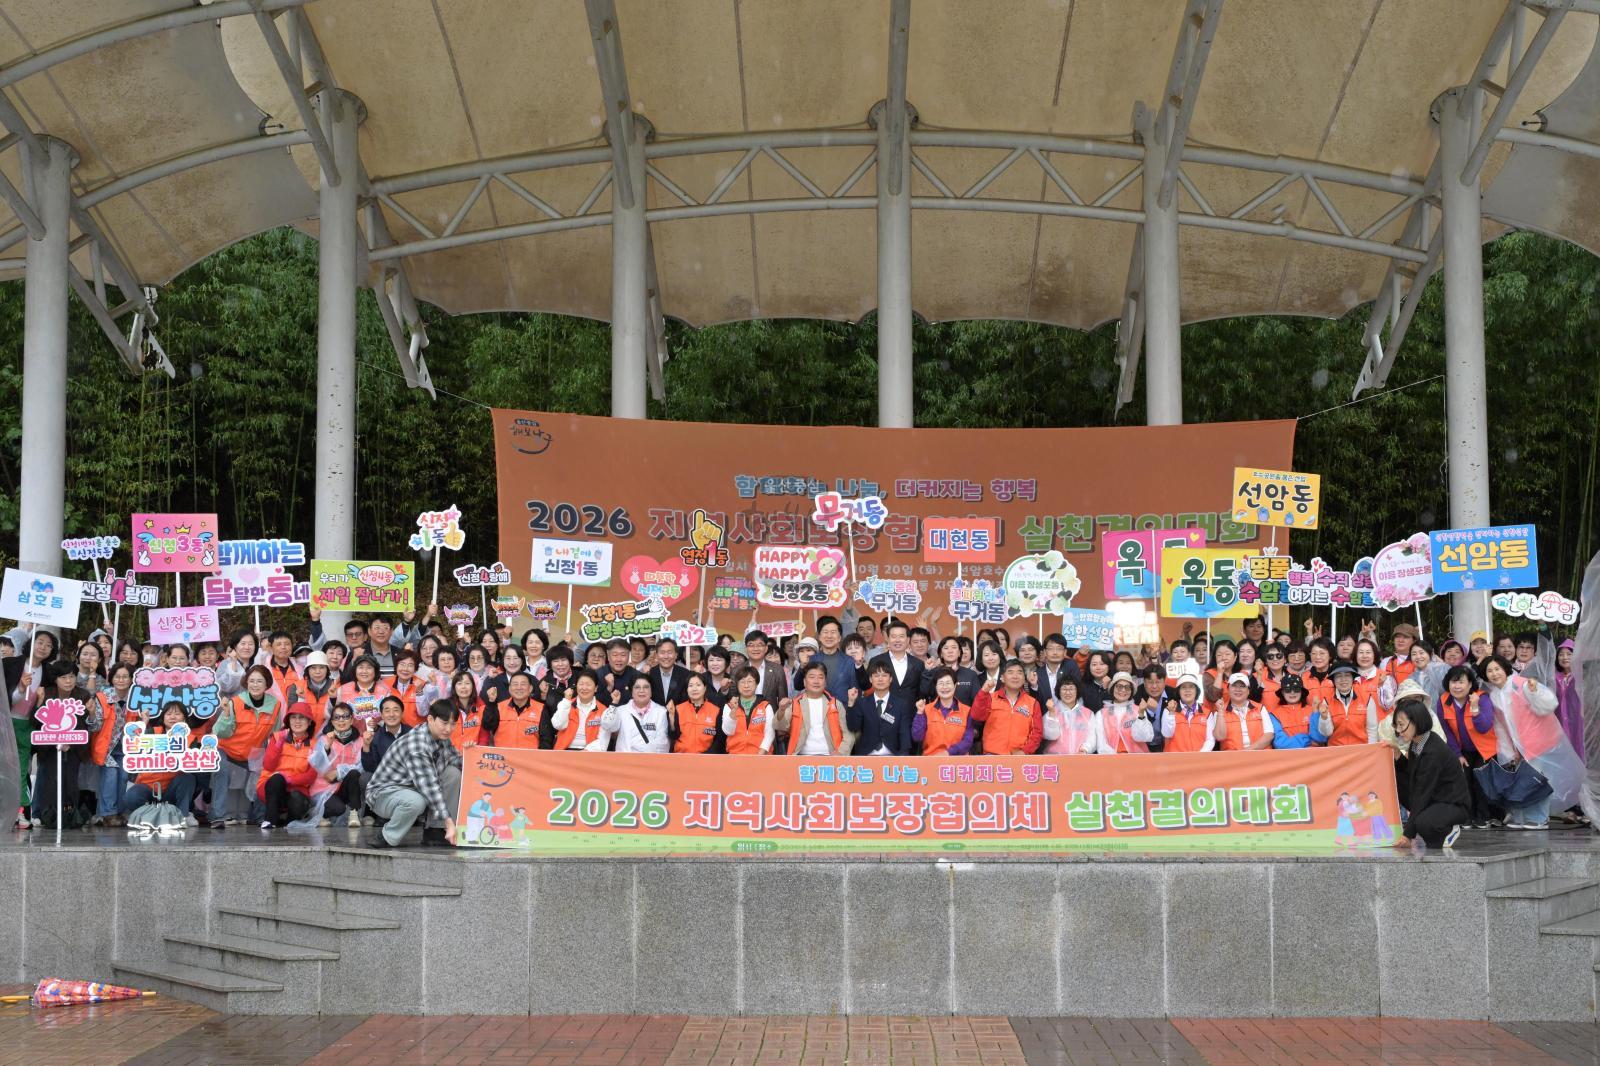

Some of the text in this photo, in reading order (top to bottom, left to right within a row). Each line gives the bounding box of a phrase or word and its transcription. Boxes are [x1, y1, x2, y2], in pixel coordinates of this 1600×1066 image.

[895, 479, 982, 502] 더커지는
[990, 478, 1036, 502] 행복
[1239, 481, 1315, 514] 선암동
[420, 511, 449, 529] 신정
[526, 500, 633, 537] 2026
[815, 494, 885, 531] 무거동
[148, 536, 205, 554] 신정3동
[929, 529, 989, 550] 대현동
[78, 546, 112, 558] 신정5동
[218, 540, 303, 566] 함께하는
[681, 541, 729, 567] 열정1동
[759, 550, 811, 564] HAPPY
[1437, 539, 1530, 573] 선암동
[319, 569, 394, 584] 우리가 신정4동
[544, 558, 598, 577] 신정1동
[758, 566, 810, 580] HAPPY
[884, 564, 914, 577] 20일
[1250, 557, 1290, 580] 명품
[1289, 570, 1315, 586] 행복
[1317, 568, 1350, 588] 수직
[80, 578, 158, 605] 신정4랑해
[1180, 557, 1237, 605] 옥동
[18, 590, 64, 609] 삼호동
[319, 586, 409, 606] 제일 잘나가!
[771, 582, 830, 603] 신정2동
[871, 593, 918, 612] 무거동
[1290, 587, 1329, 604] 여기는
[157, 611, 212, 632] 신정5동
[588, 602, 636, 623] 신정1동
[953, 600, 1005, 622] 무거동
[583, 616, 666, 642] 행정복지센터
[129, 684, 219, 717] 삼산동
[125, 736, 183, 752] 남구중심
[126, 751, 217, 769] smile 삼산
[798, 763, 1060, 785] 함께하는 나눔, 더커지는 행복
[546, 783, 1312, 834] 2026 지역사회보장협의체 실천결의대회
